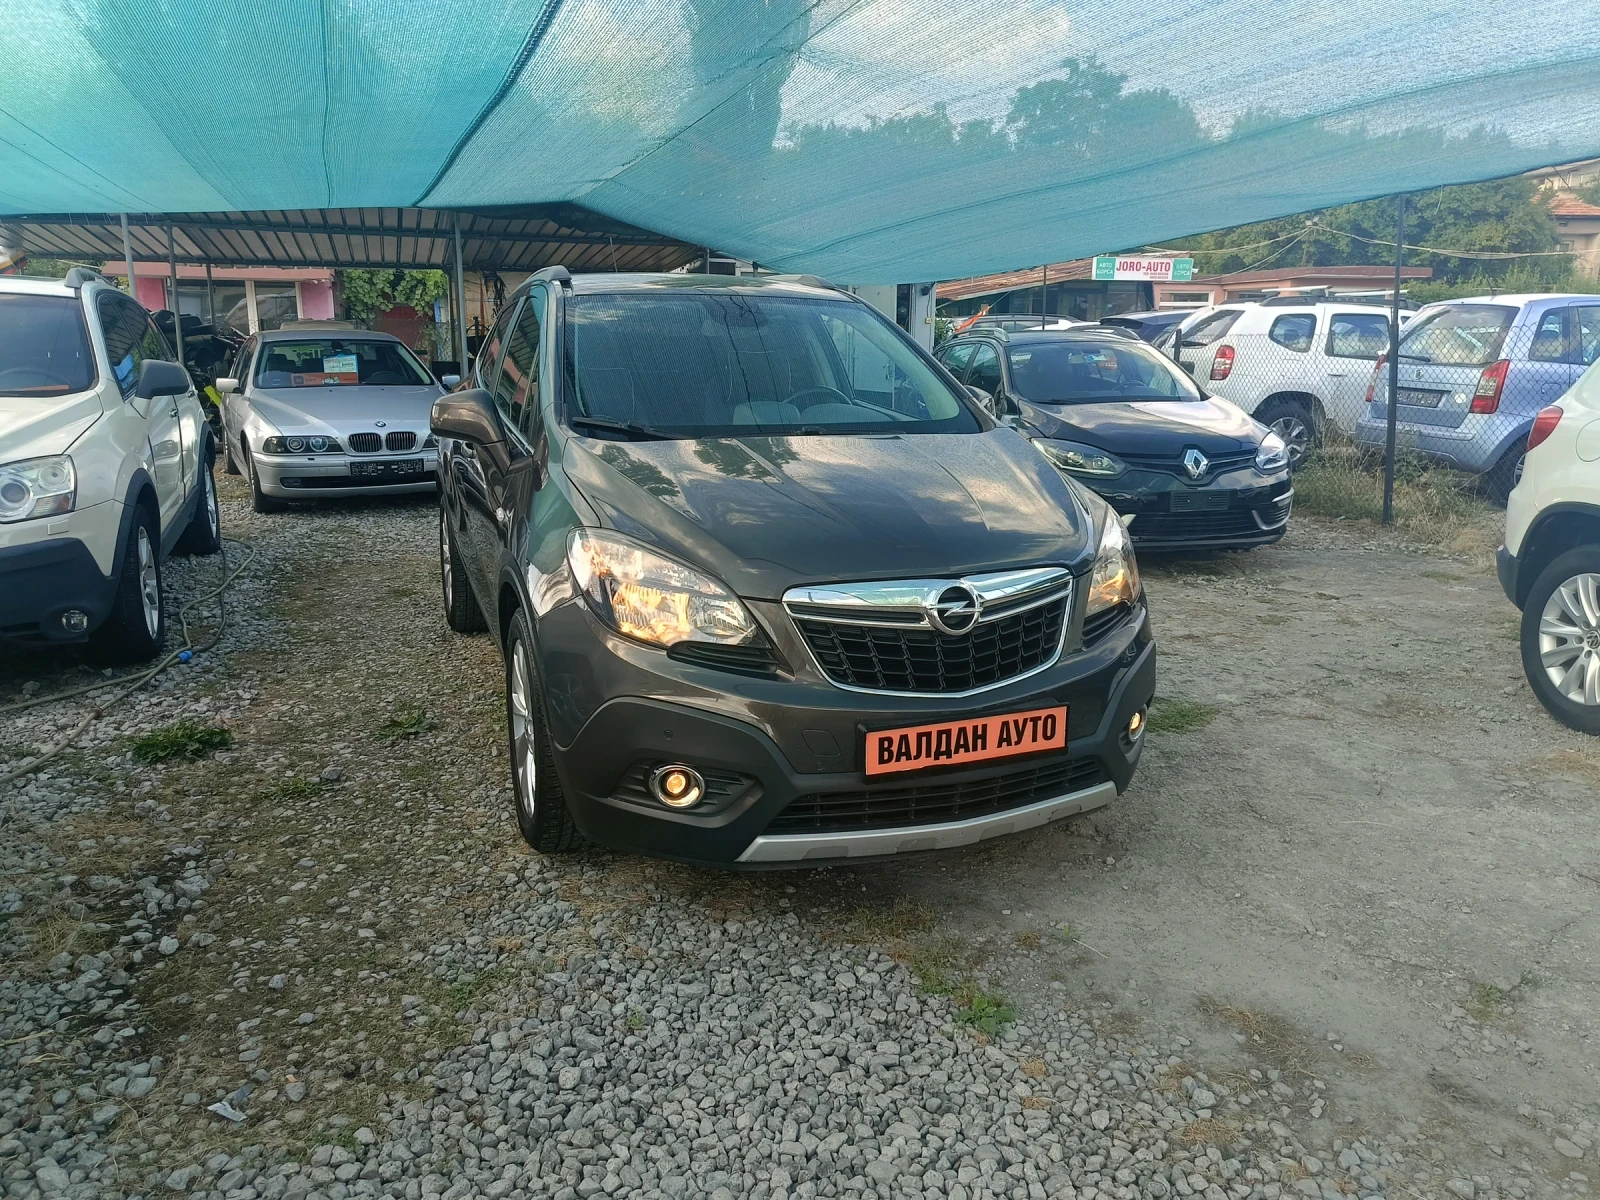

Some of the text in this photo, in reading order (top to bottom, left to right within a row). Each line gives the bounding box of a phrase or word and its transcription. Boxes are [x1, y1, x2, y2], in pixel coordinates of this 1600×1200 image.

[1116, 261, 1171, 272] JORO-AUTO
[878, 713, 1057, 765] ВАЛДАН АУТО
